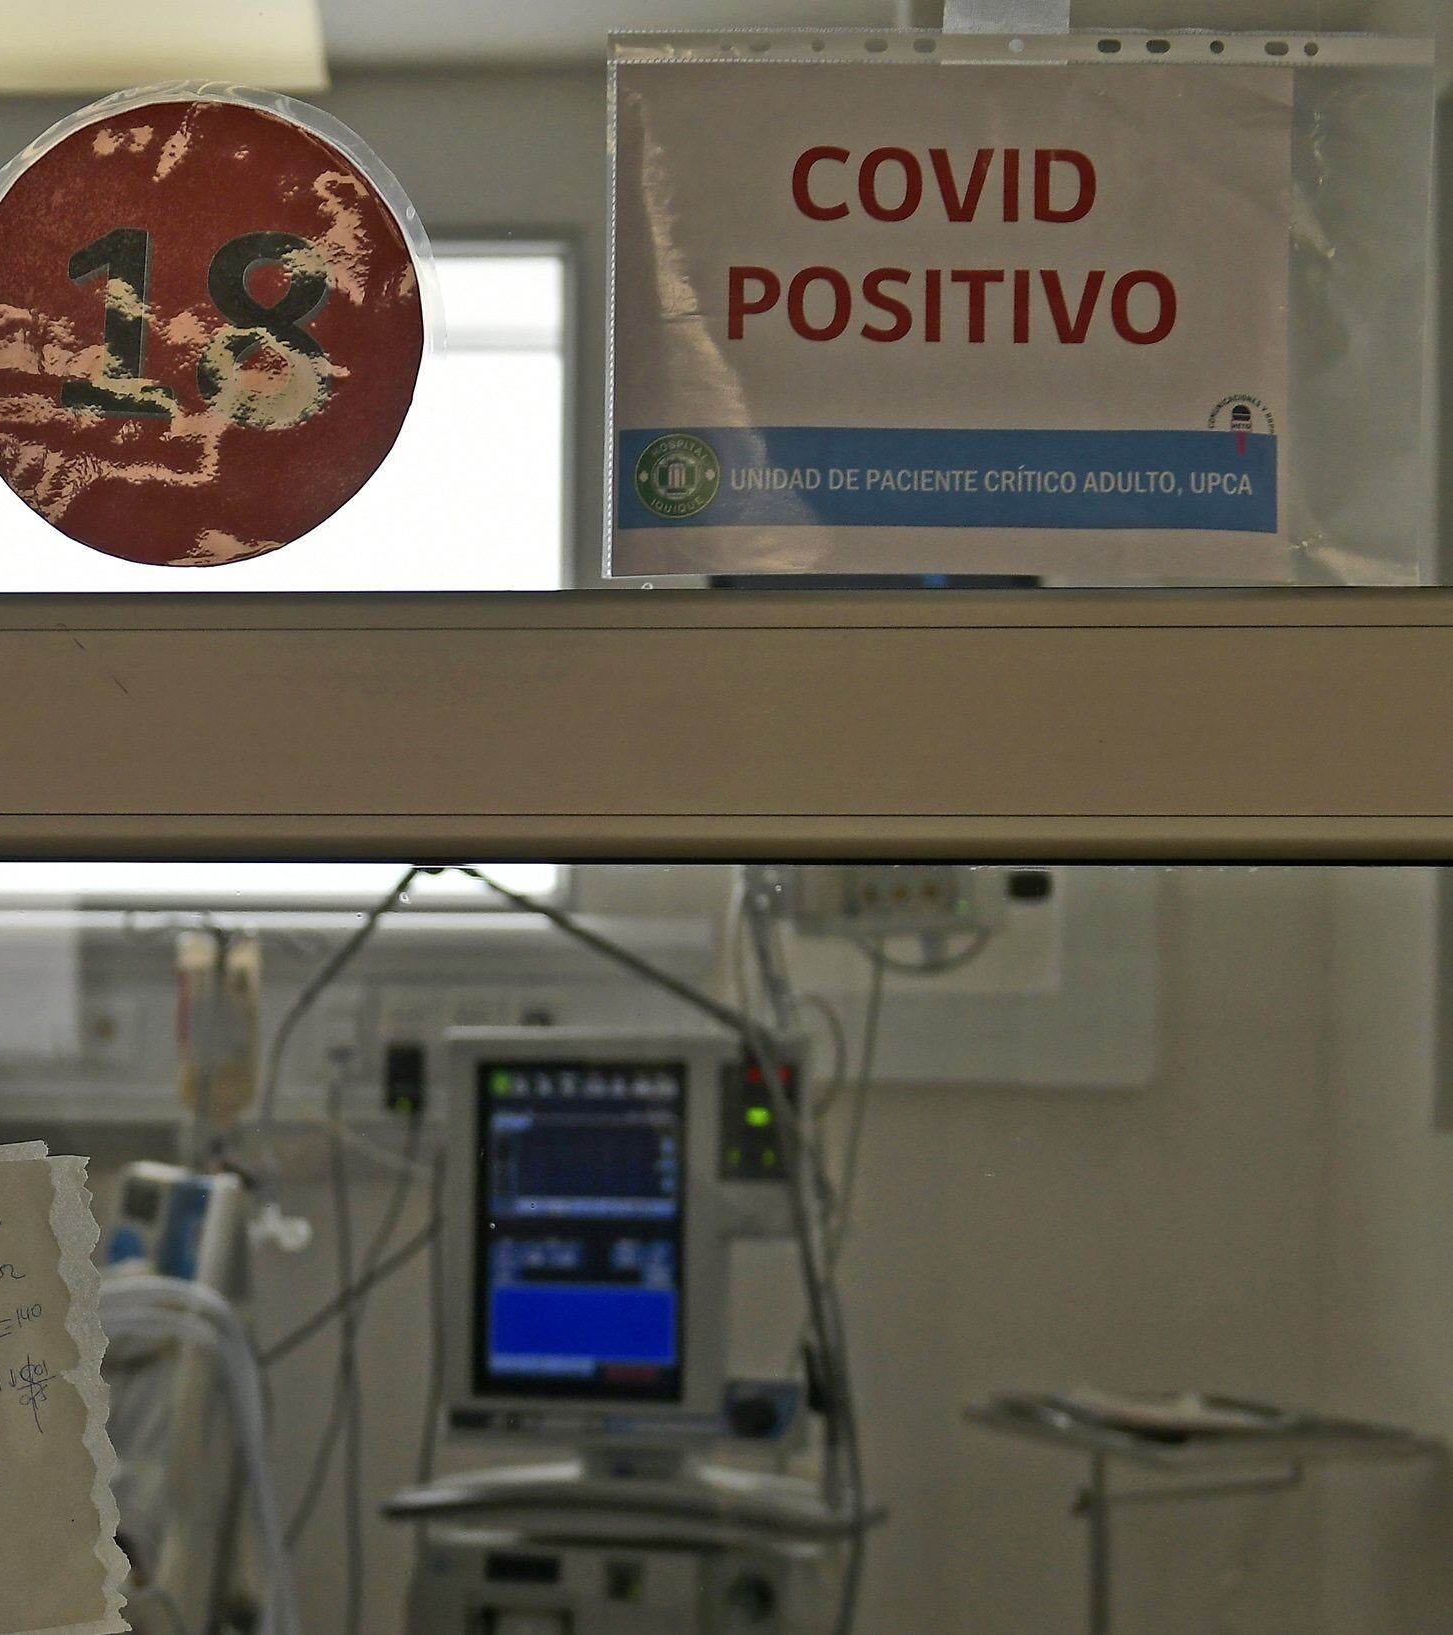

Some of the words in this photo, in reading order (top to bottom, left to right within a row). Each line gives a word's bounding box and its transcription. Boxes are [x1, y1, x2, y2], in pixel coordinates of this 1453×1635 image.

[792, 146, 1096, 223] COVID
[60, 227, 332, 430] 18
[728, 266, 1177, 345] POSITIVO
[651, 440, 707, 459] HOSPITAL
[650, 498, 703, 513] IQUIQUE
[731, 468, 821, 490] UNIDAD
[829, 469, 859, 490] DE
[866, 469, 978, 491] PACIENTE
[984, 465, 1077, 493] CRÍTICO
[1082, 471, 1183, 497] ADULTO,
[1190, 472, 1253, 495] UPCA
